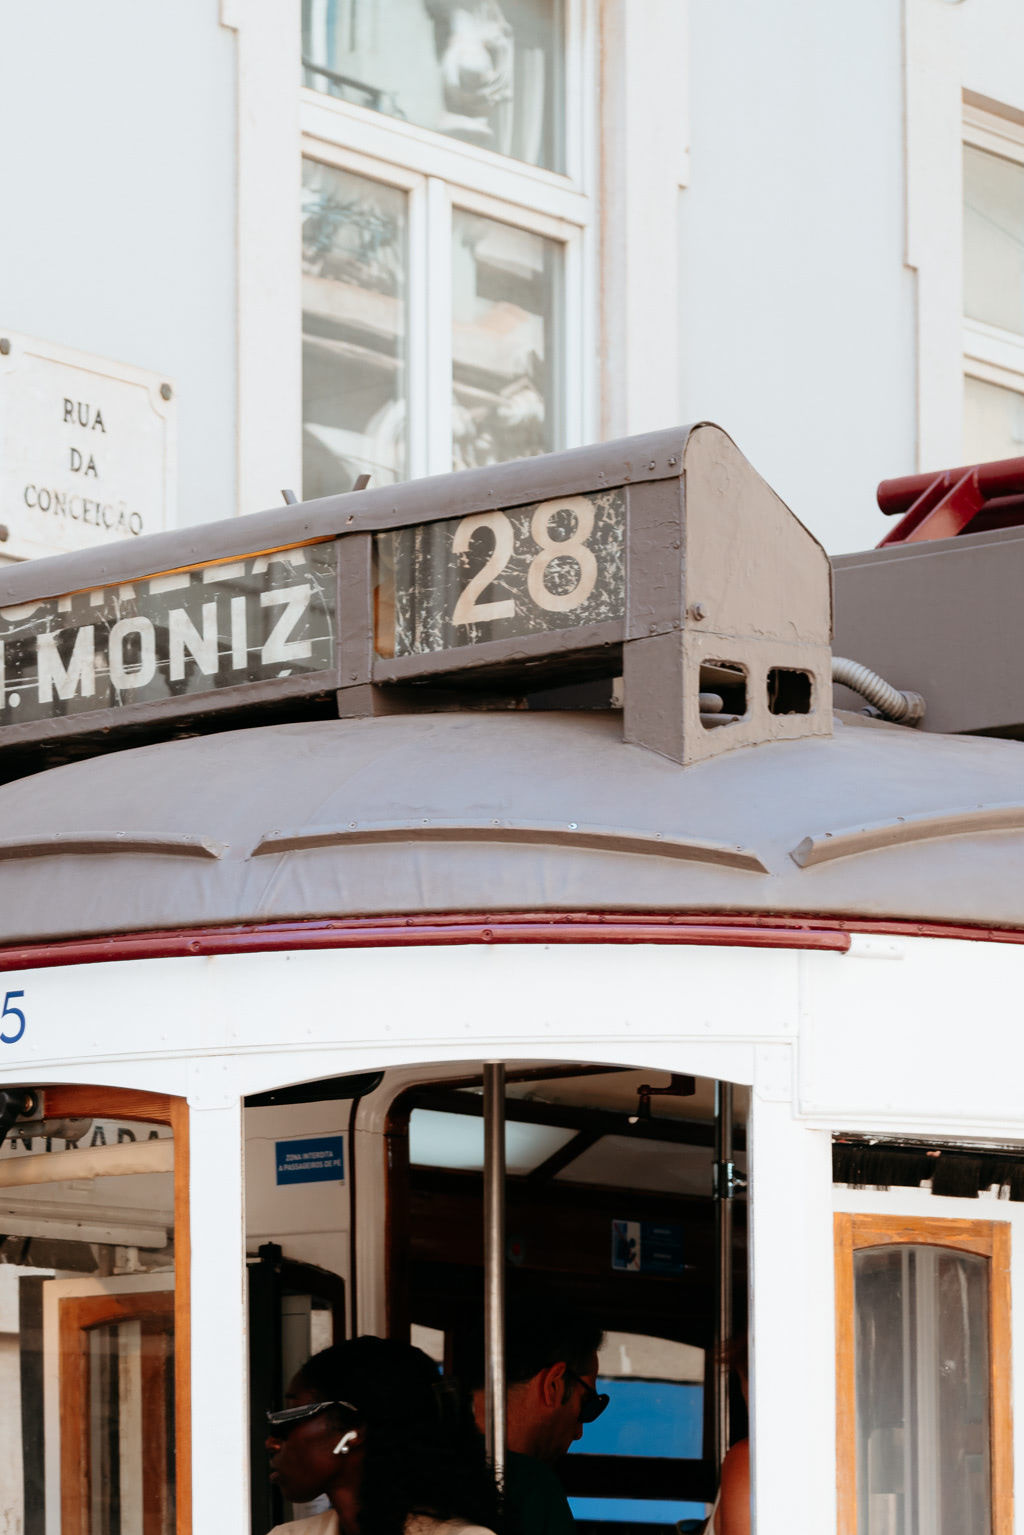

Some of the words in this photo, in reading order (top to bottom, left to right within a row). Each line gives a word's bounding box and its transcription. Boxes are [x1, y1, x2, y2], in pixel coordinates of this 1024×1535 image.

[63, 398, 107, 433] RUA
[69, 447, 99, 478] DA
[23, 484, 144, 536] CONCEIÇÃO
[451, 496, 599, 626] 28
